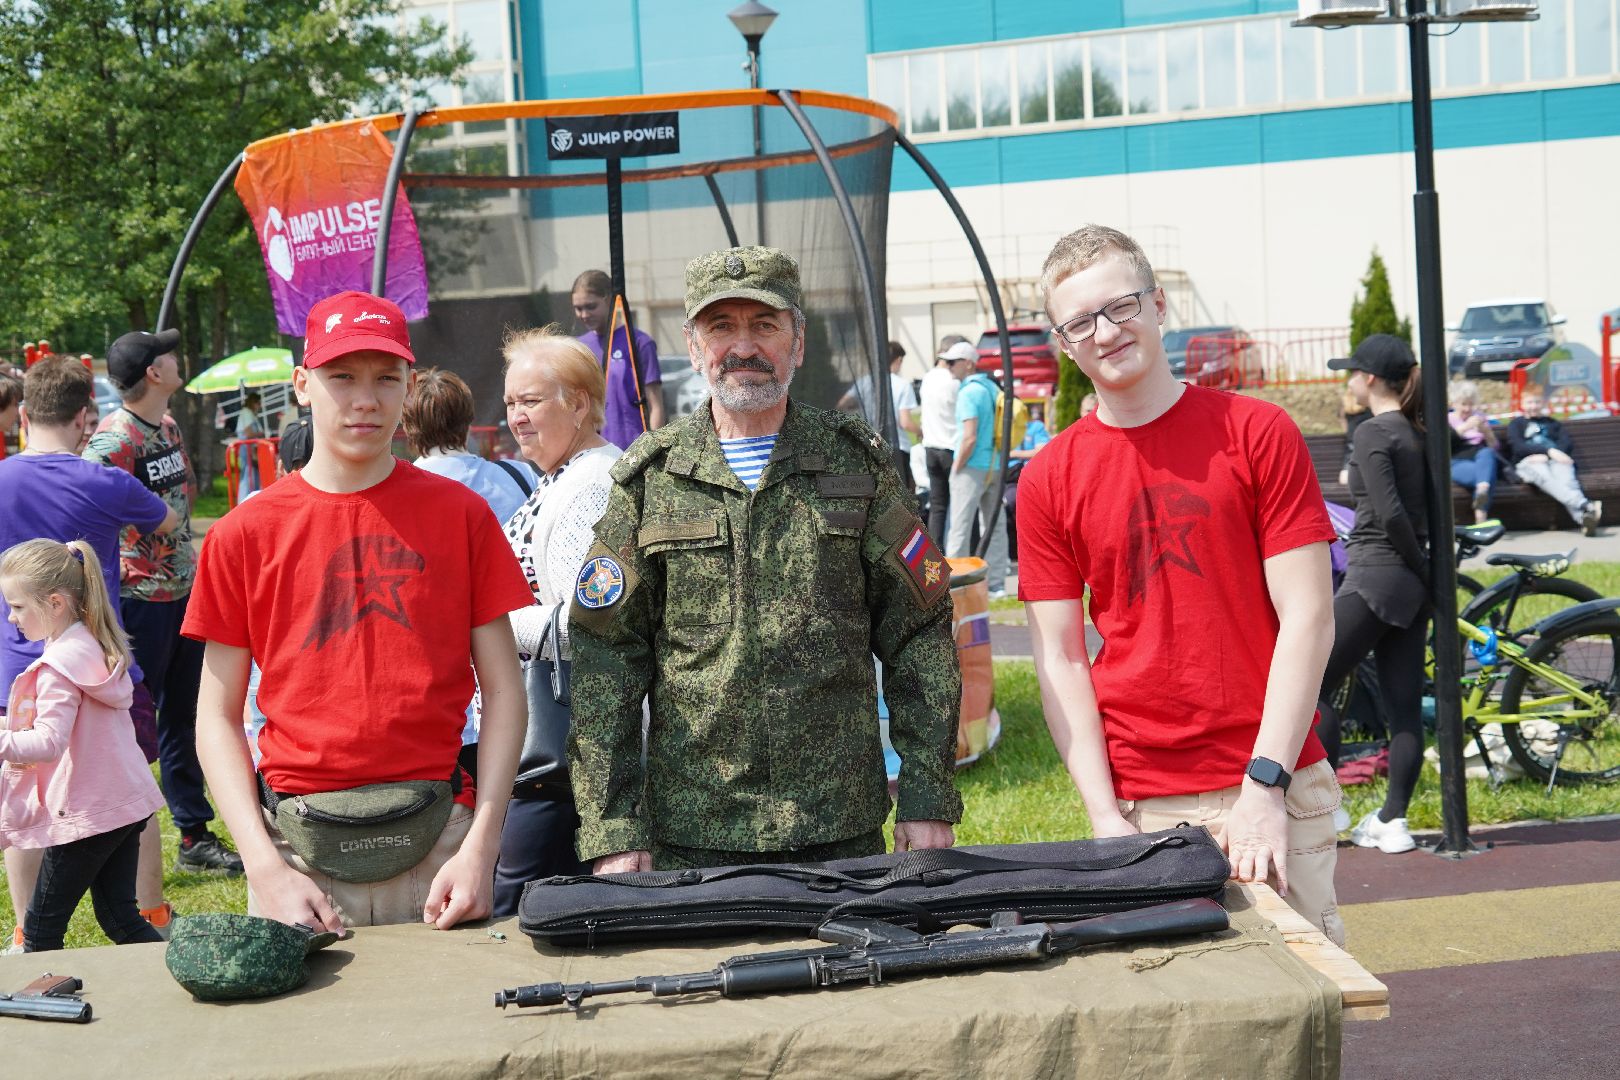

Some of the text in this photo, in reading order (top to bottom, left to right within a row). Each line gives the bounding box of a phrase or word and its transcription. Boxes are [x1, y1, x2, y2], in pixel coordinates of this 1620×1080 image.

[579, 126, 675, 146] JUMP POWER
[288, 198, 381, 244] IMPULSE
[340, 834, 411, 853] CONVERSE
